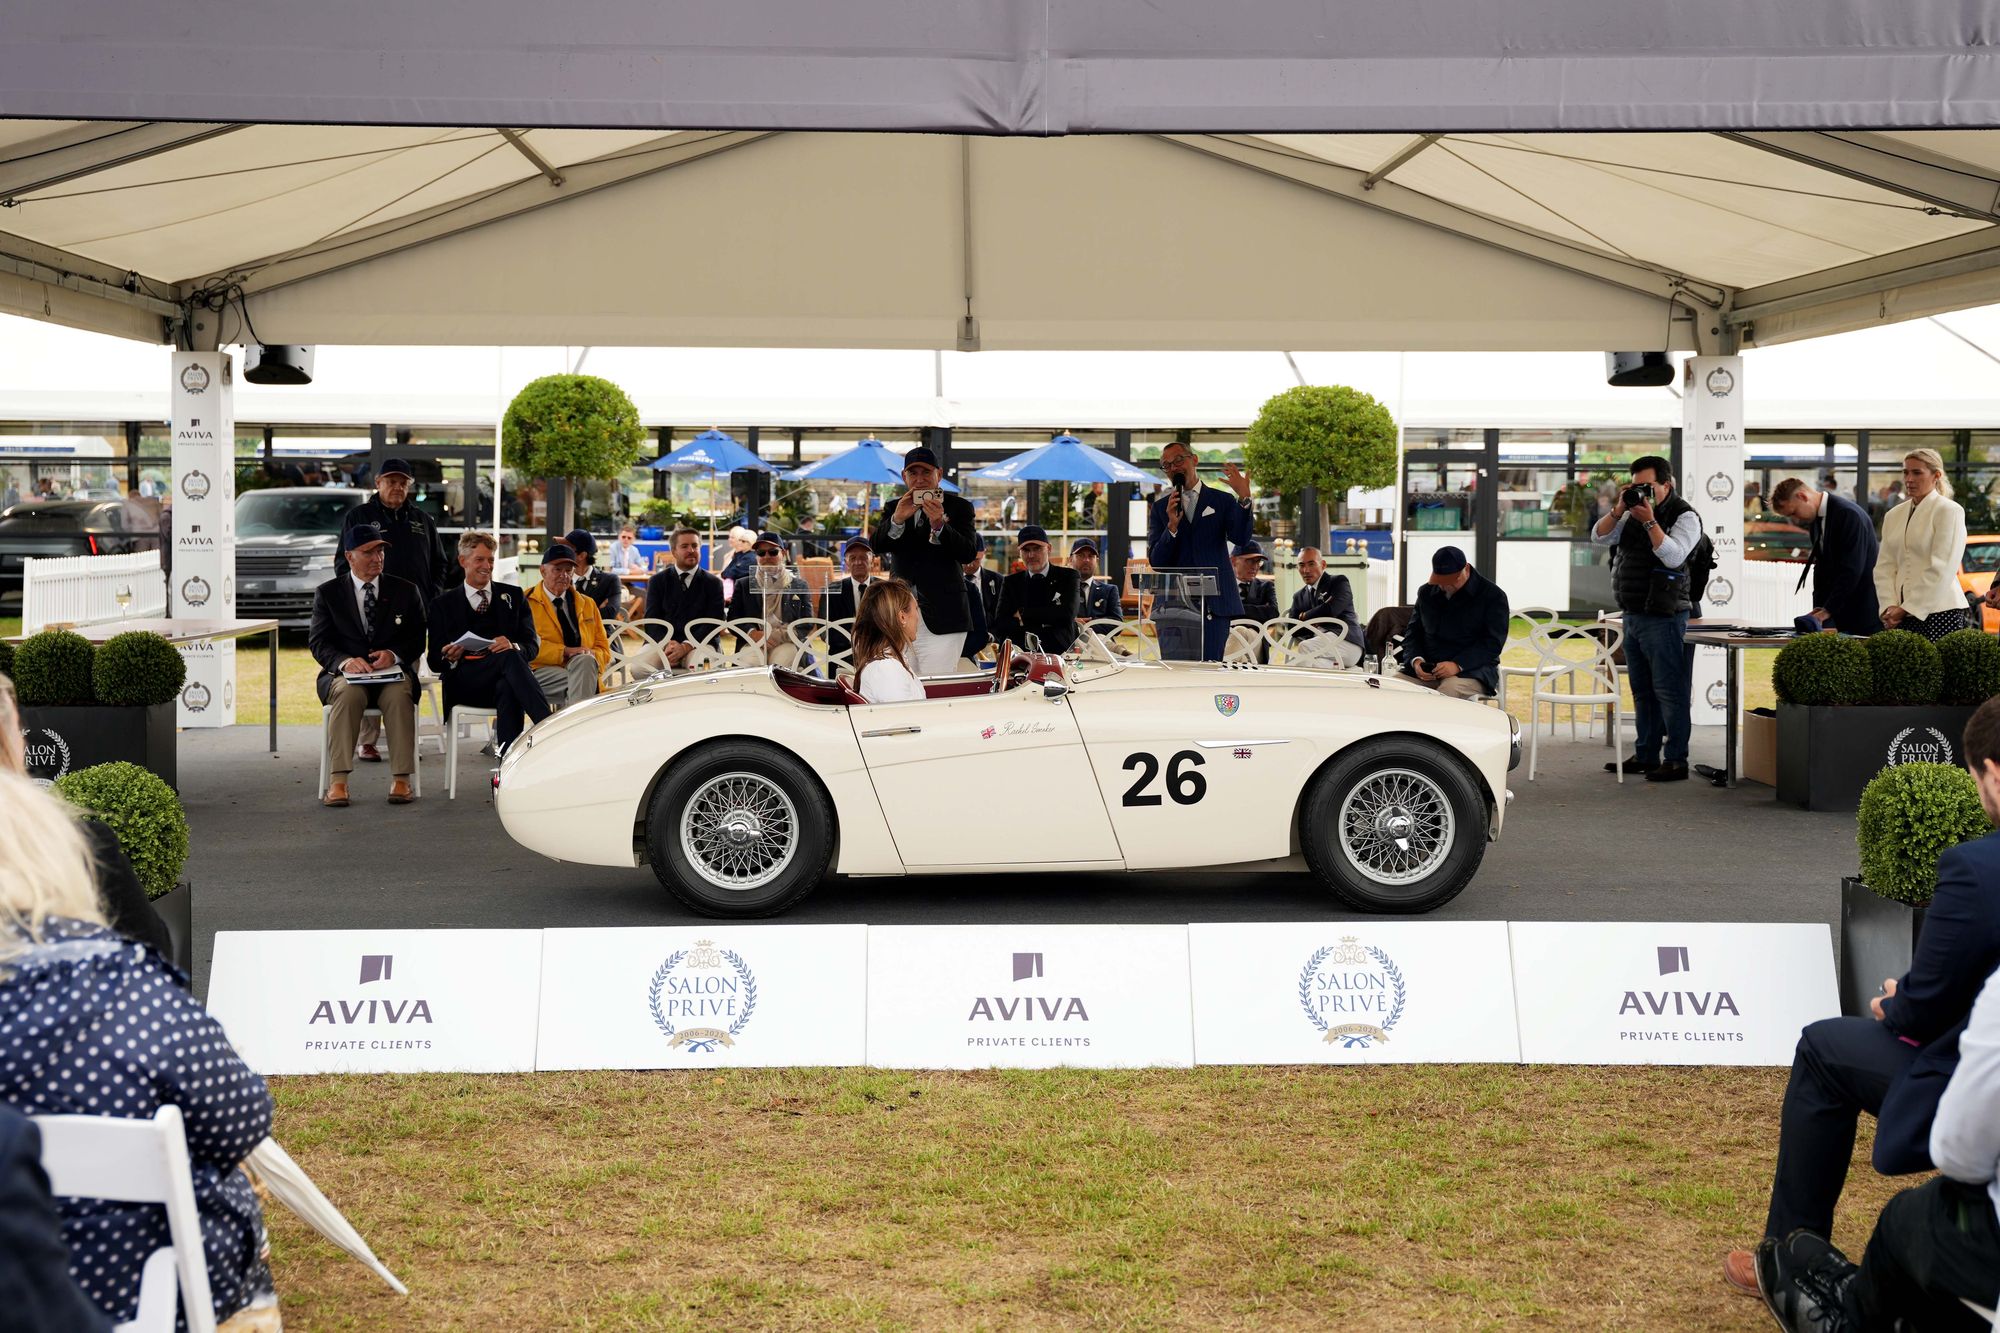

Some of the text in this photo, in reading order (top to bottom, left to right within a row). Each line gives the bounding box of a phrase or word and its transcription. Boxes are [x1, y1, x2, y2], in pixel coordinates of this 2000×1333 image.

[1711, 538, 1737, 546] VIVA
[23, 744, 56, 755] ALON
[1901, 743, 1939, 753] SALON
[25, 754, 56, 766] RIVÉ
[1122, 749, 1207, 807] 26
[668, 976, 738, 995] SALON
[1317, 972, 1386, 990] SALON
[668, 995, 737, 1017] PRIVÉ
[968, 997, 1090, 1021] AVIVA
[1320, 991, 1387, 1012] PRIVÉ
[1619, 991, 1740, 1016] AVIVA
[309, 999, 433, 1025] AVIVA
[305, 1040, 432, 1050] PRIVATE CLIENTS
[968, 1038, 1091, 1046] PRIVATE CLIENTS
[1620, 1031, 1744, 1042] PRIVATE CLIENTS
